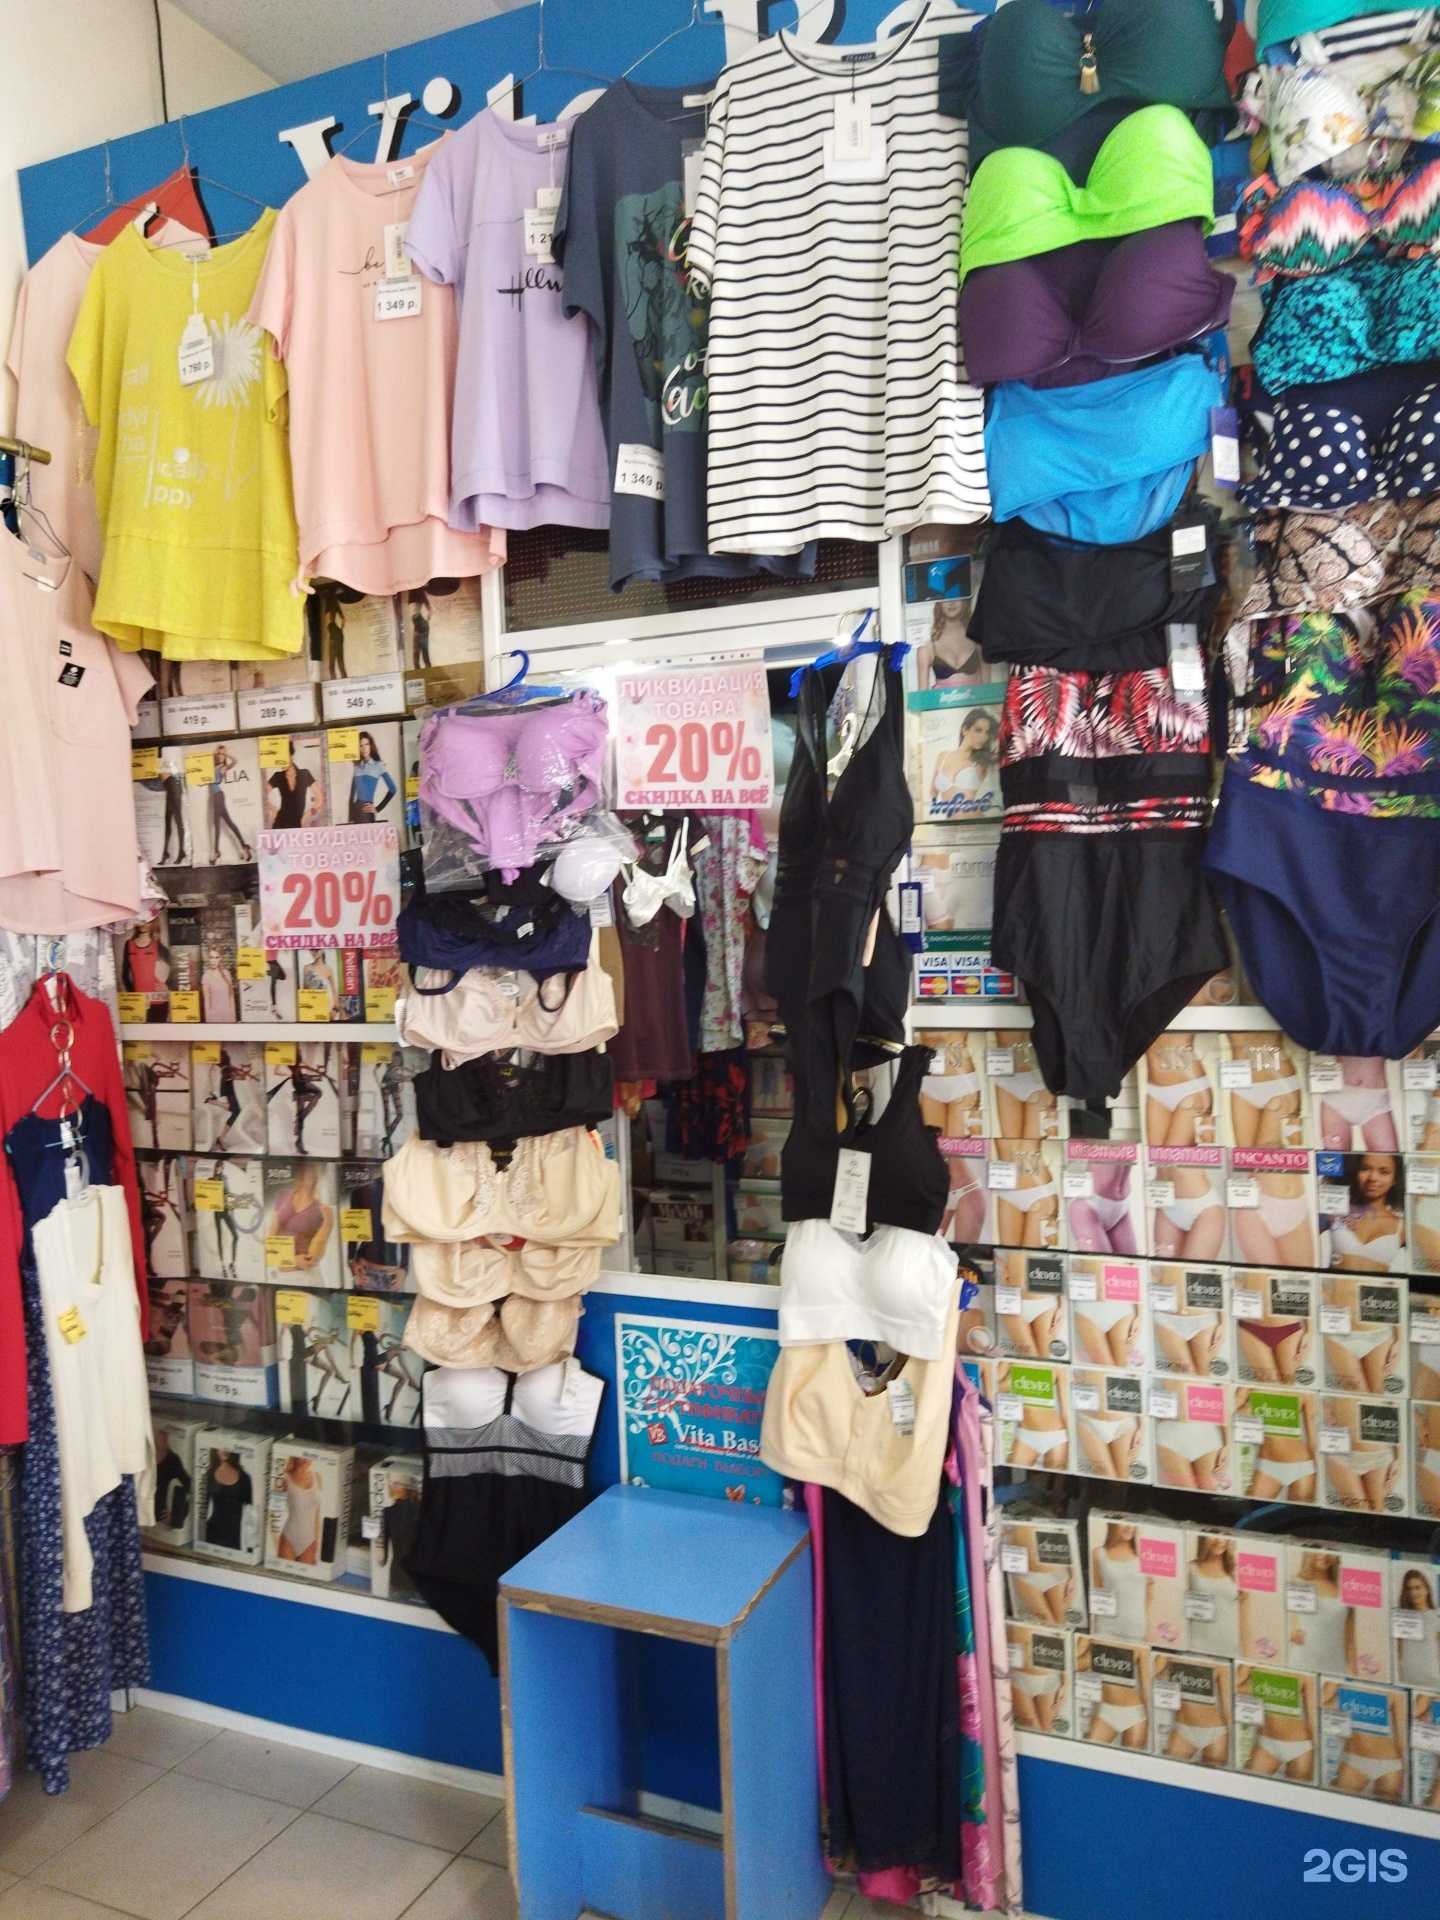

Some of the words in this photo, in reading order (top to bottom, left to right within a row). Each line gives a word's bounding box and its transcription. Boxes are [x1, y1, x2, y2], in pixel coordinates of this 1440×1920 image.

[385, 299, 405, 311] 349
[630, 474, 653, 486] 349
[621, 672, 764, 698] ЛИКВИДАЦИЯ
[656, 700, 737, 719] ТОВАРА
[645, 720, 761, 783] 20%
[624, 789, 707, 807] СКИДКА
[711, 788, 734, 804] НА
[256, 826, 399, 850] ЛИКВИДАЦИЯ
[287, 851, 366, 868] ТОВАРА
[282, 870, 393, 929] 20%
[265, 933, 339, 949] СКИДКА
[344, 933, 366, 946] НА
[922, 957, 947, 968] VISA
[954, 957, 980, 968] VISA
[1234, 1151, 1307, 1166] INCANTO
[679, 1423, 715, 1447] Vita
[721, 1430, 761, 1453] Bas
